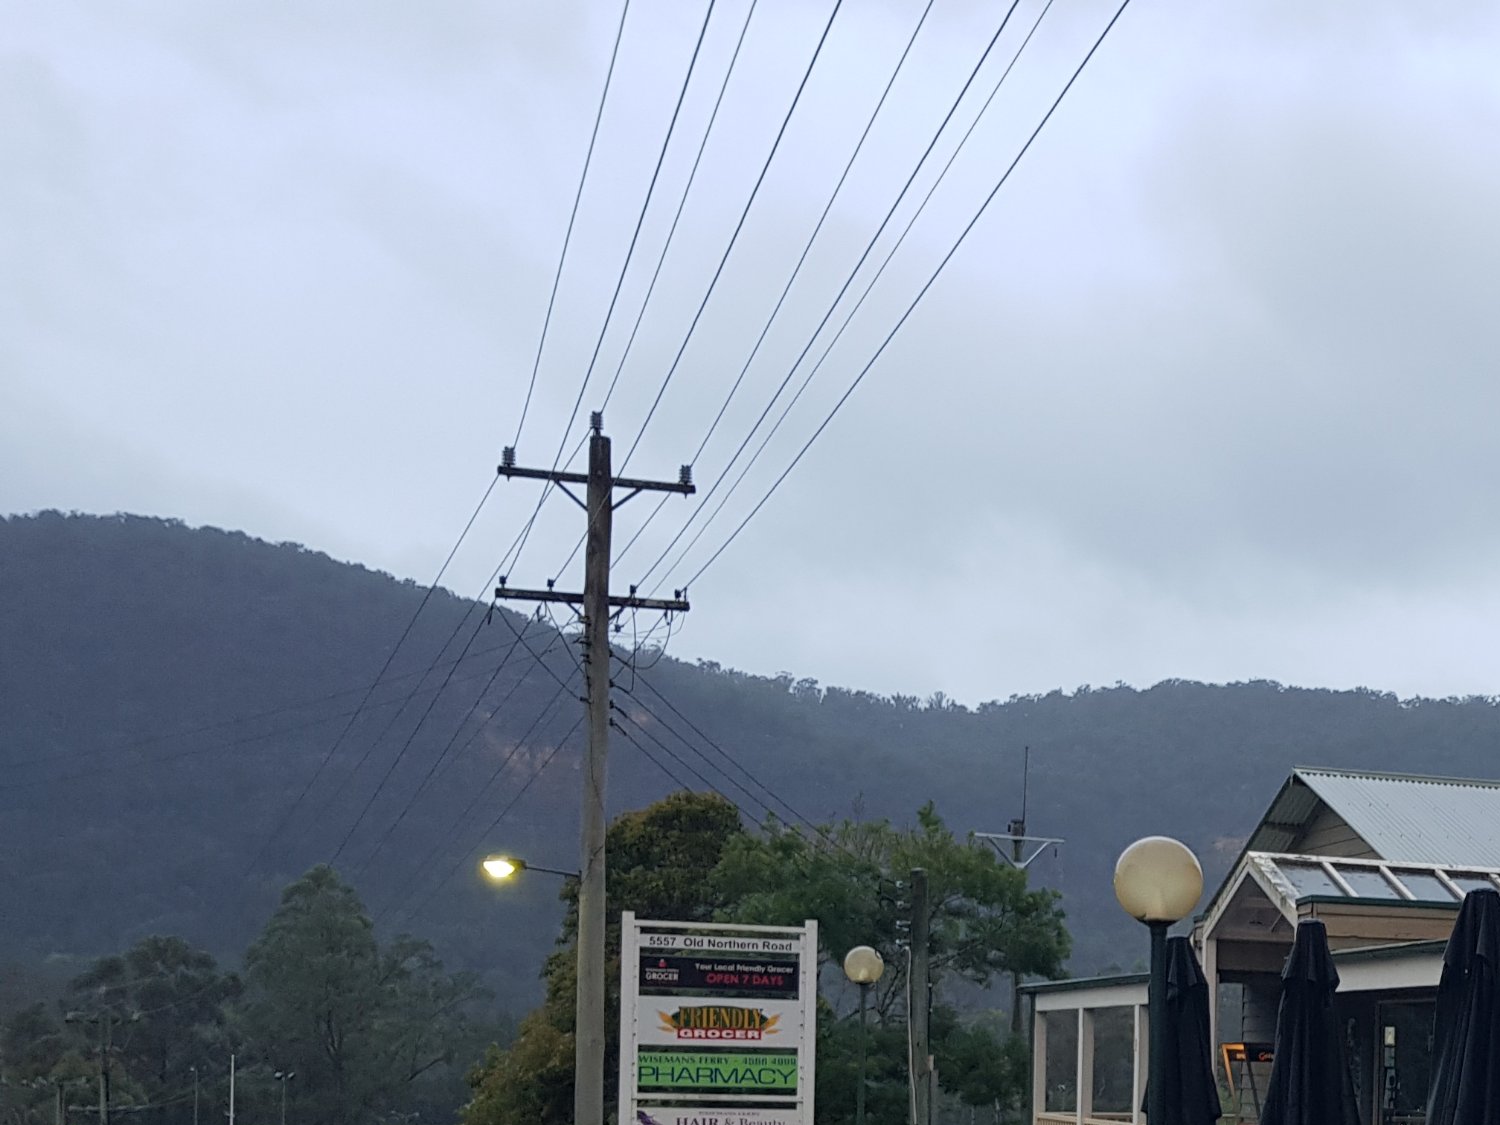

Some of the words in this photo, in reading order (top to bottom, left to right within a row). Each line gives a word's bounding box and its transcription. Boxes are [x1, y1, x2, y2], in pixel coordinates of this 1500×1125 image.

[649, 936, 677, 946] 5557
[683, 937, 704, 948] Old
[707, 938, 759, 950] Northern
[762, 940, 792, 952] Road
[714, 963, 735, 972] Local
[736, 964, 766, 974] Friendly
[767, 965, 794, 974] Grocer
[645, 971, 679, 981] GROCER
[706, 973, 739, 984] OPEN
[743, 974, 749, 984] 7
[752, 975, 784, 986] DAYS
[678, 1006, 763, 1029] FRIENDLY
[679, 1029, 760, 1039] GROCER
[638, 1055, 696, 1065] WISEMANS
[699, 1056, 730, 1065] FERRY
[638, 1066, 797, 1085] PHARMACY
